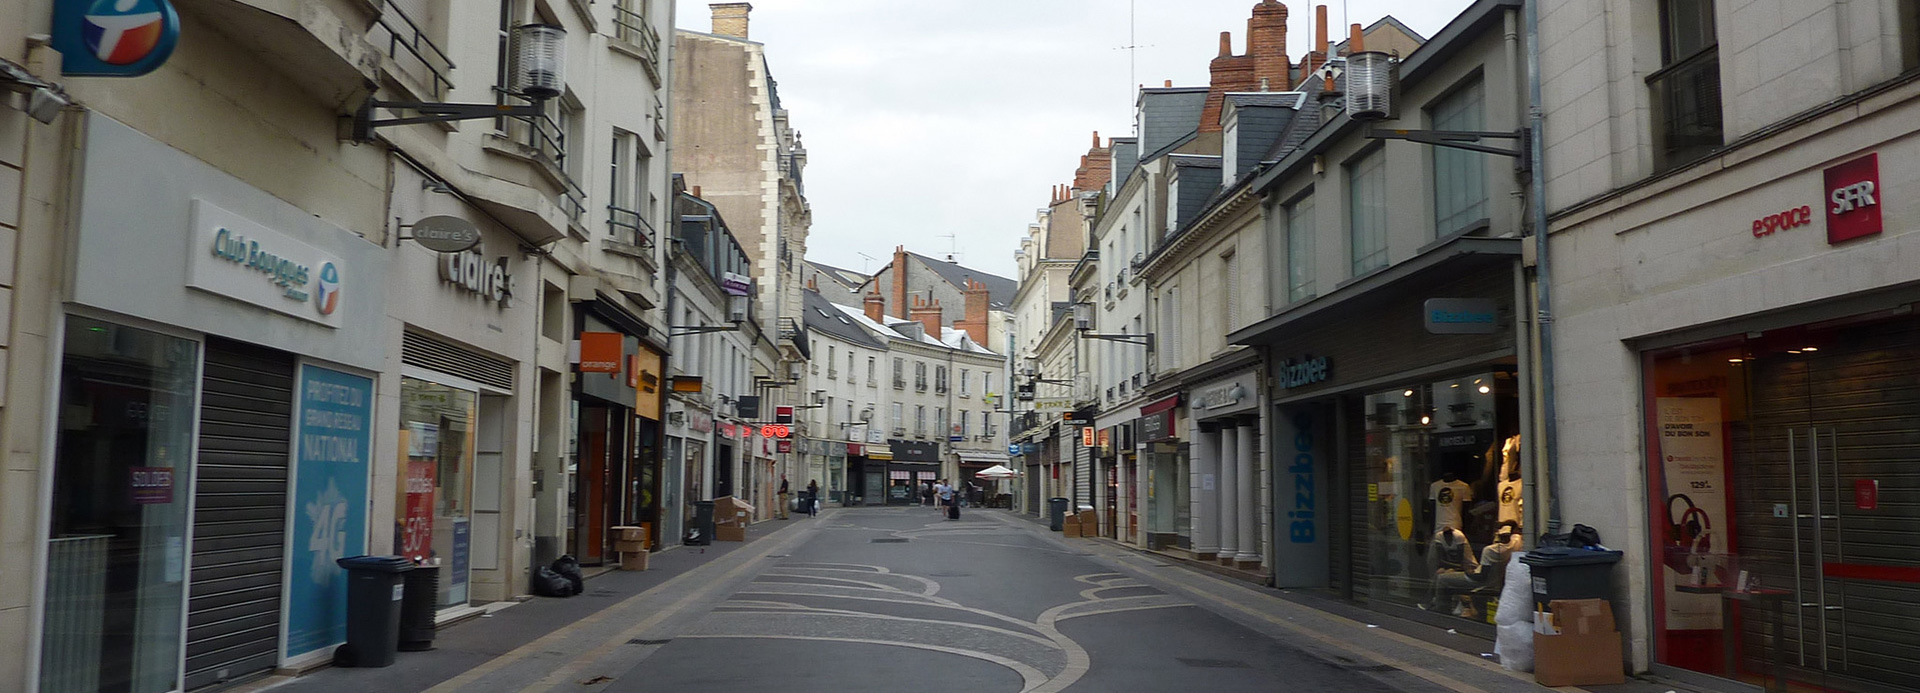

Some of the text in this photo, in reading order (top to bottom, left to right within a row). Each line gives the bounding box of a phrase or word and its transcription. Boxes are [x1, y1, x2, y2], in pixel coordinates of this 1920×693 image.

[1752, 181, 1877, 238] espace SFR
[416, 226, 473, 241] claire's
[214, 228, 309, 288] Club Bouygues
[1431, 308, 1494, 323] Bizzbee
[581, 361, 618, 370] orange
[1279, 356, 1327, 389] Bizzbee
[306, 380, 362, 407] PROFITEZ DU
[305, 408, 333, 428] GRAND
[303, 434, 359, 462] NATIONAL
[132, 471, 171, 487] SOLDES
[1288, 409, 1315, 543] Bizzbee
[308, 503, 347, 561] 4G
